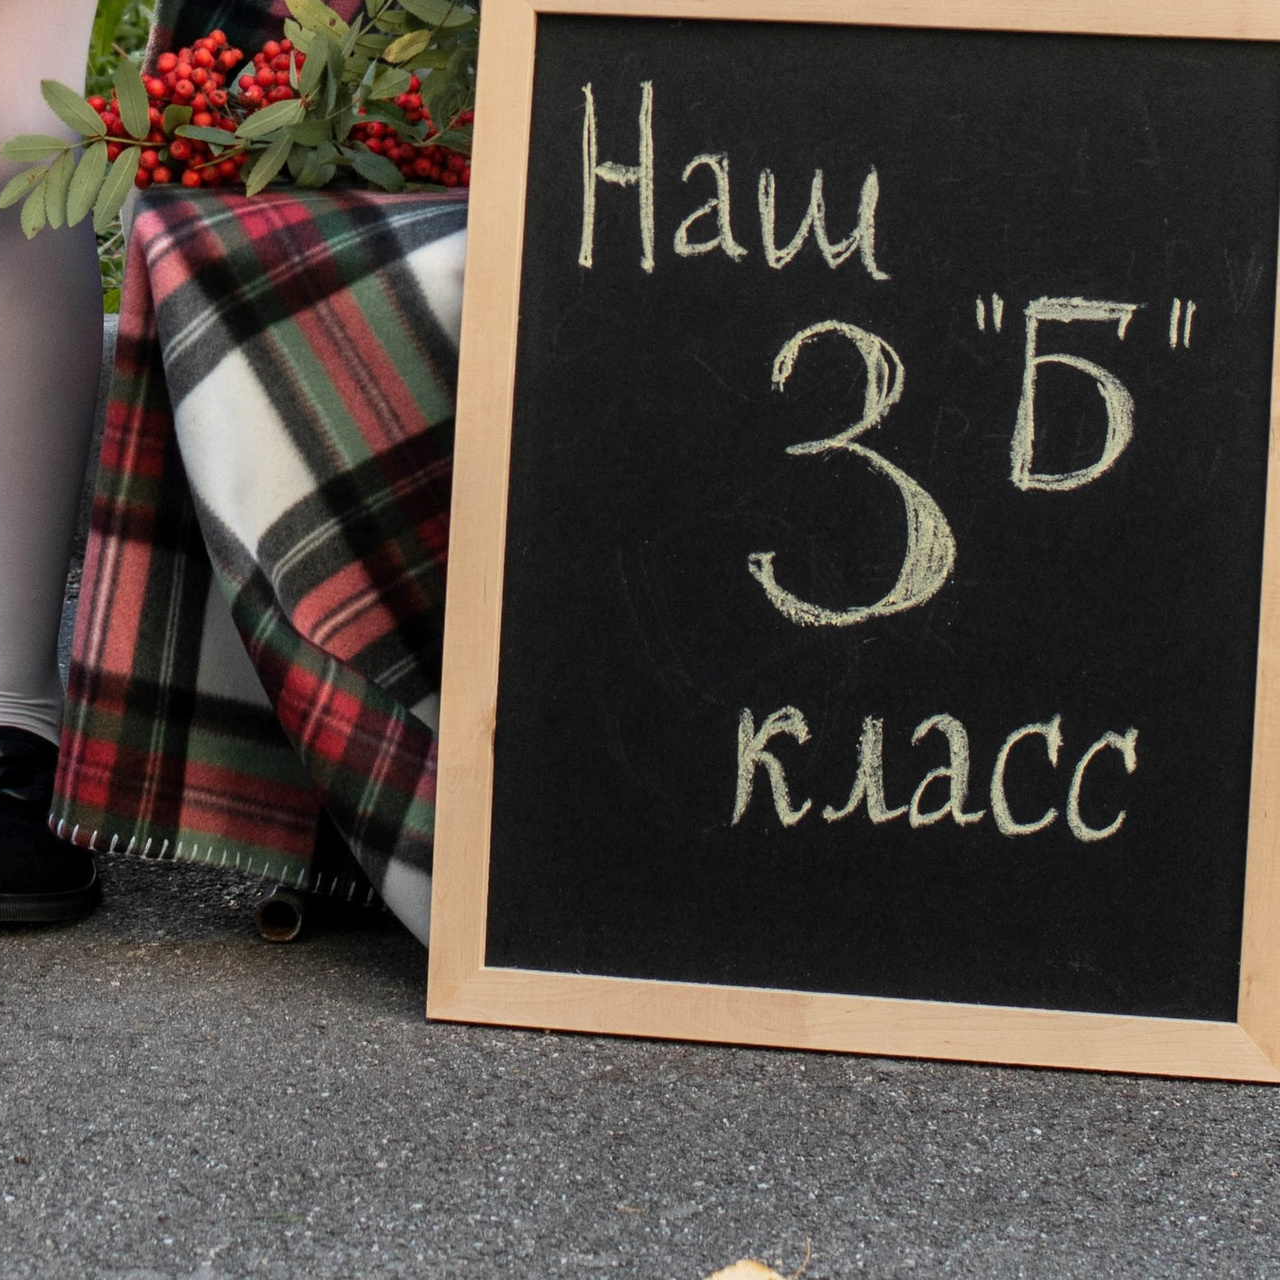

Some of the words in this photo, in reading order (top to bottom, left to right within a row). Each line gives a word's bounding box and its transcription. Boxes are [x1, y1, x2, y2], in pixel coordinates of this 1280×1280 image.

[577, 78, 891, 281] Наш
[748, 319, 957, 628] 3
[730, 703, 1140, 843] класс
